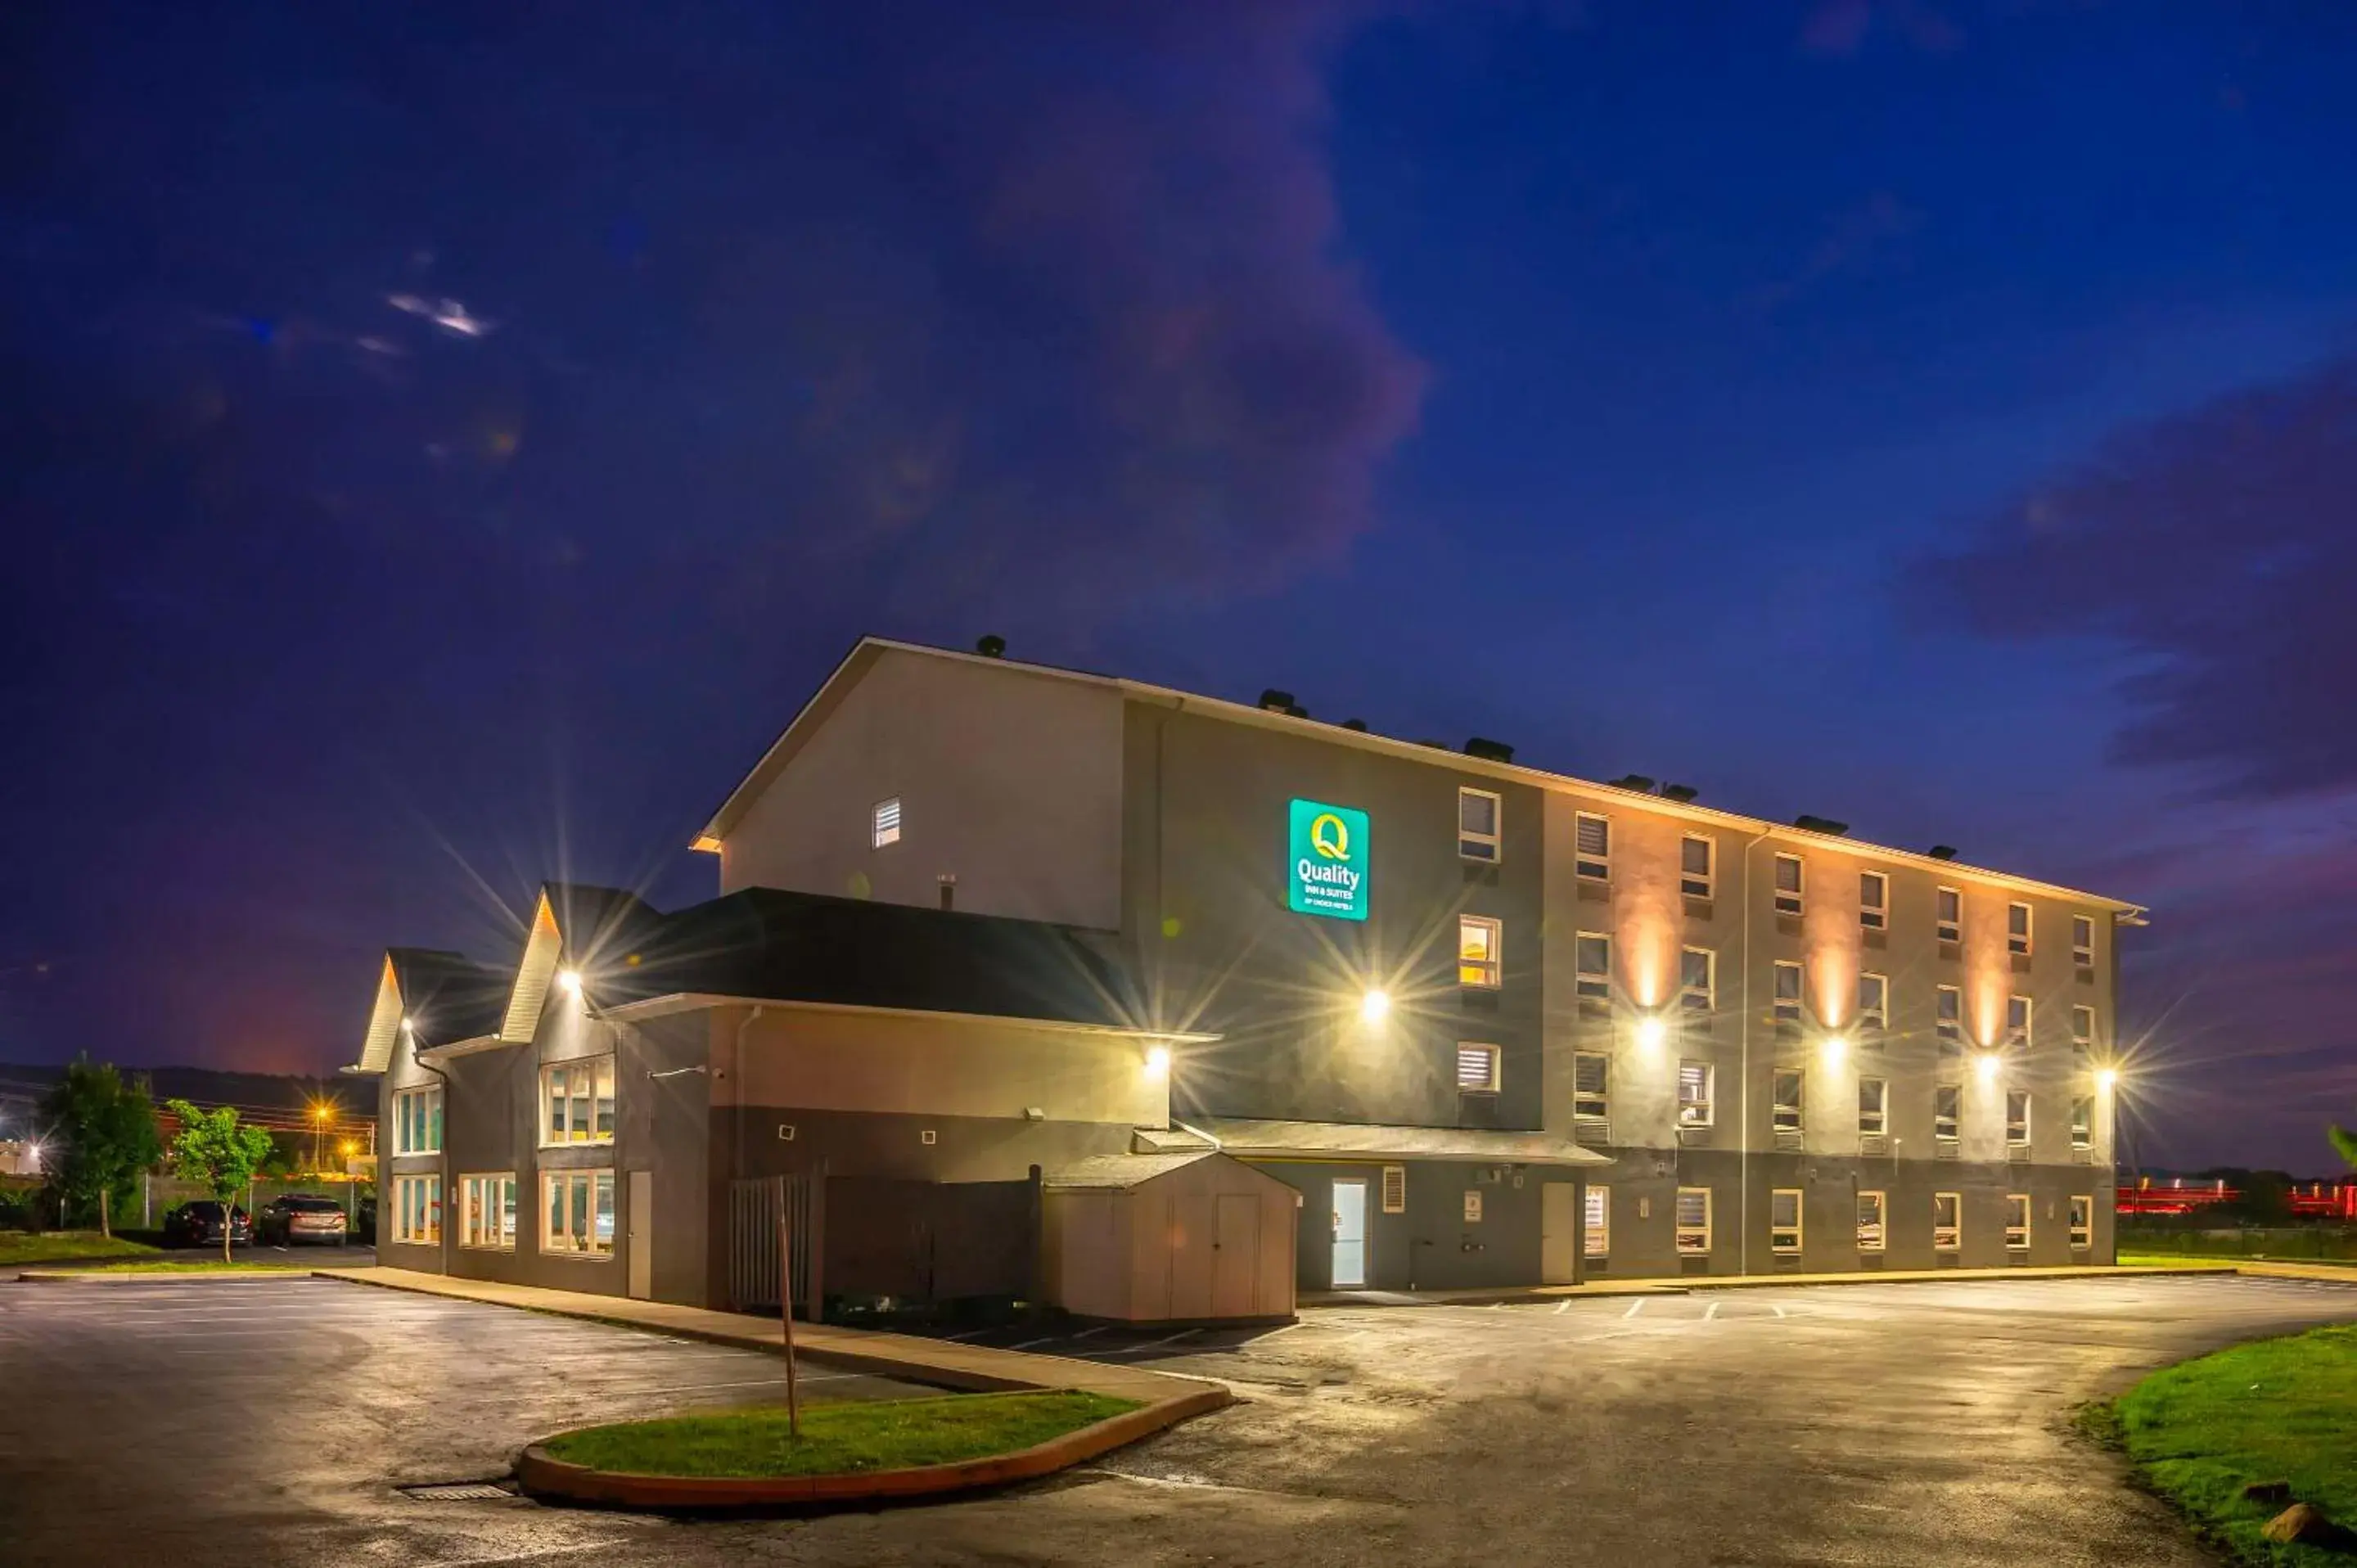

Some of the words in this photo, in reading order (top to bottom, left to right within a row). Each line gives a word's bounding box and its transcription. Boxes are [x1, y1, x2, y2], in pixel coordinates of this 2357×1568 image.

[1311, 813, 1350, 861] Q
[1298, 858, 1359, 890] Quality
[1326, 888, 1353, 899] SUITES
